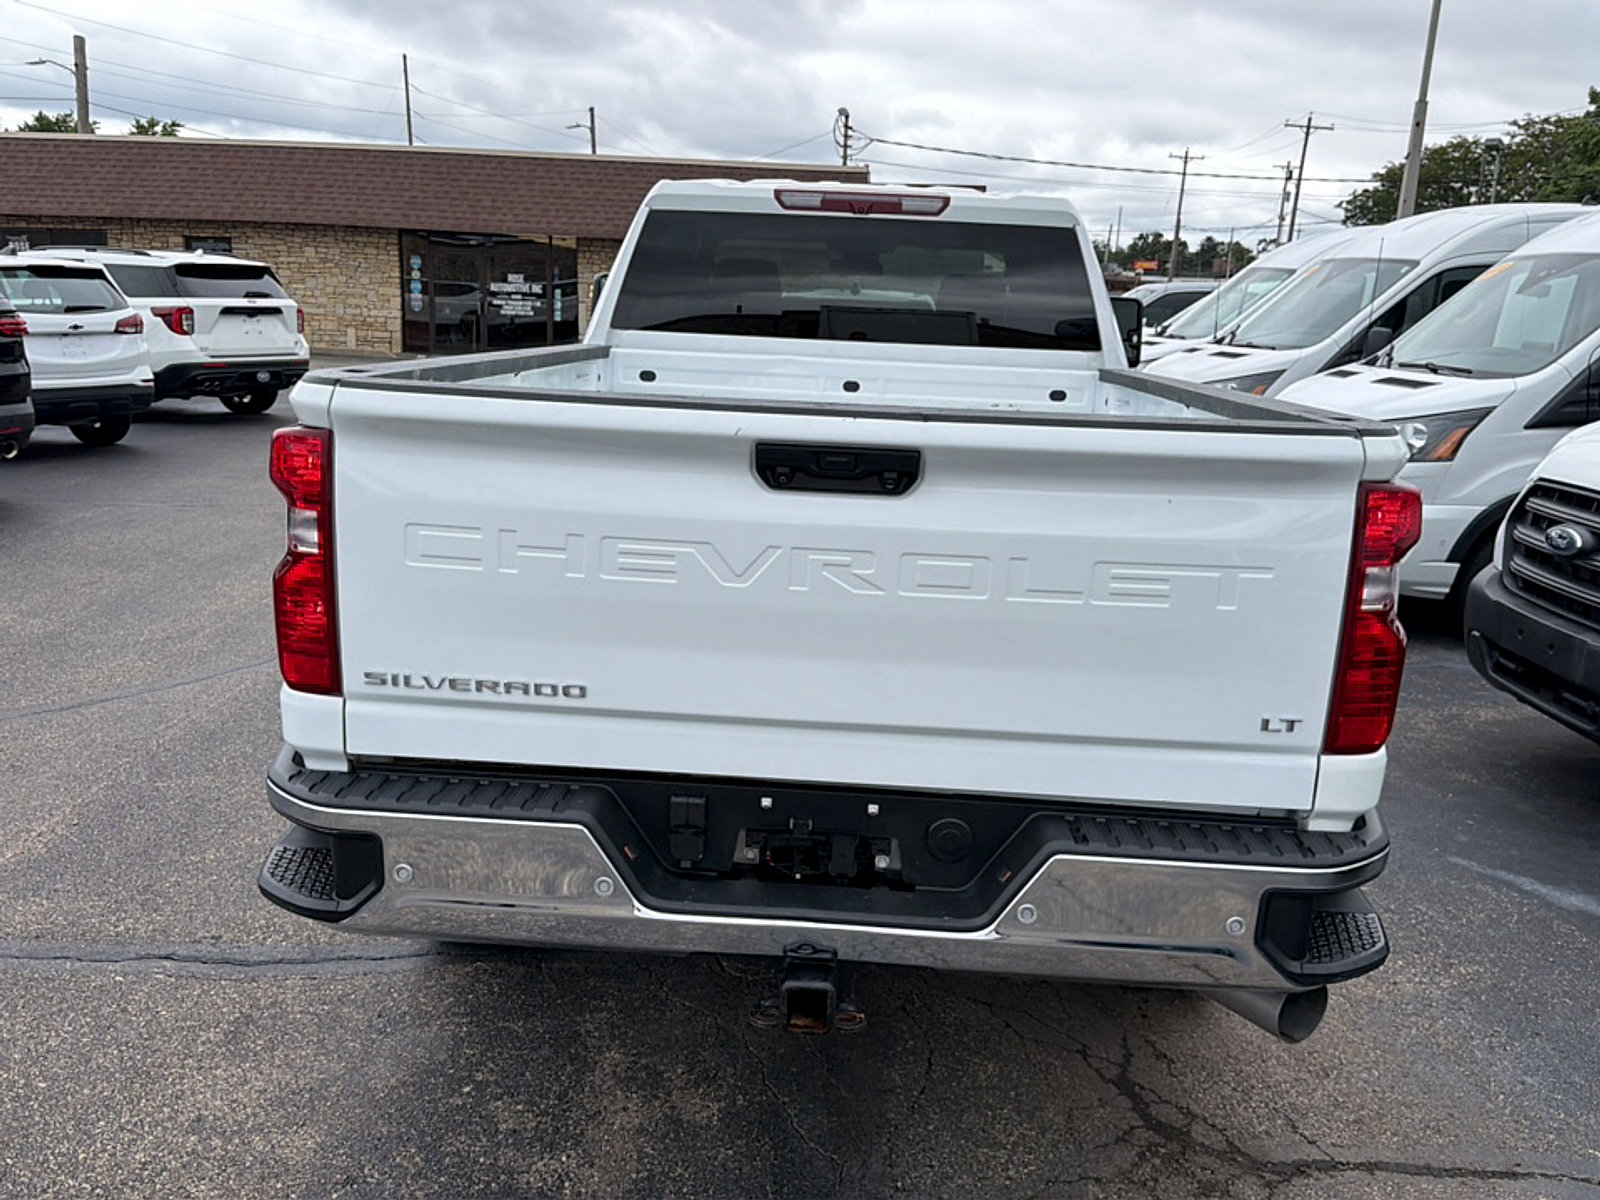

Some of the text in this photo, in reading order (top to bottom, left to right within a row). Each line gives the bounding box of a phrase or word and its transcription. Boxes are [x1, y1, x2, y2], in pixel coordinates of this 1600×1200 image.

[404, 522, 1275, 611] CHEVROLET
[362, 671, 588, 699] SILVERADO
[1260, 718, 1304, 733] LT
